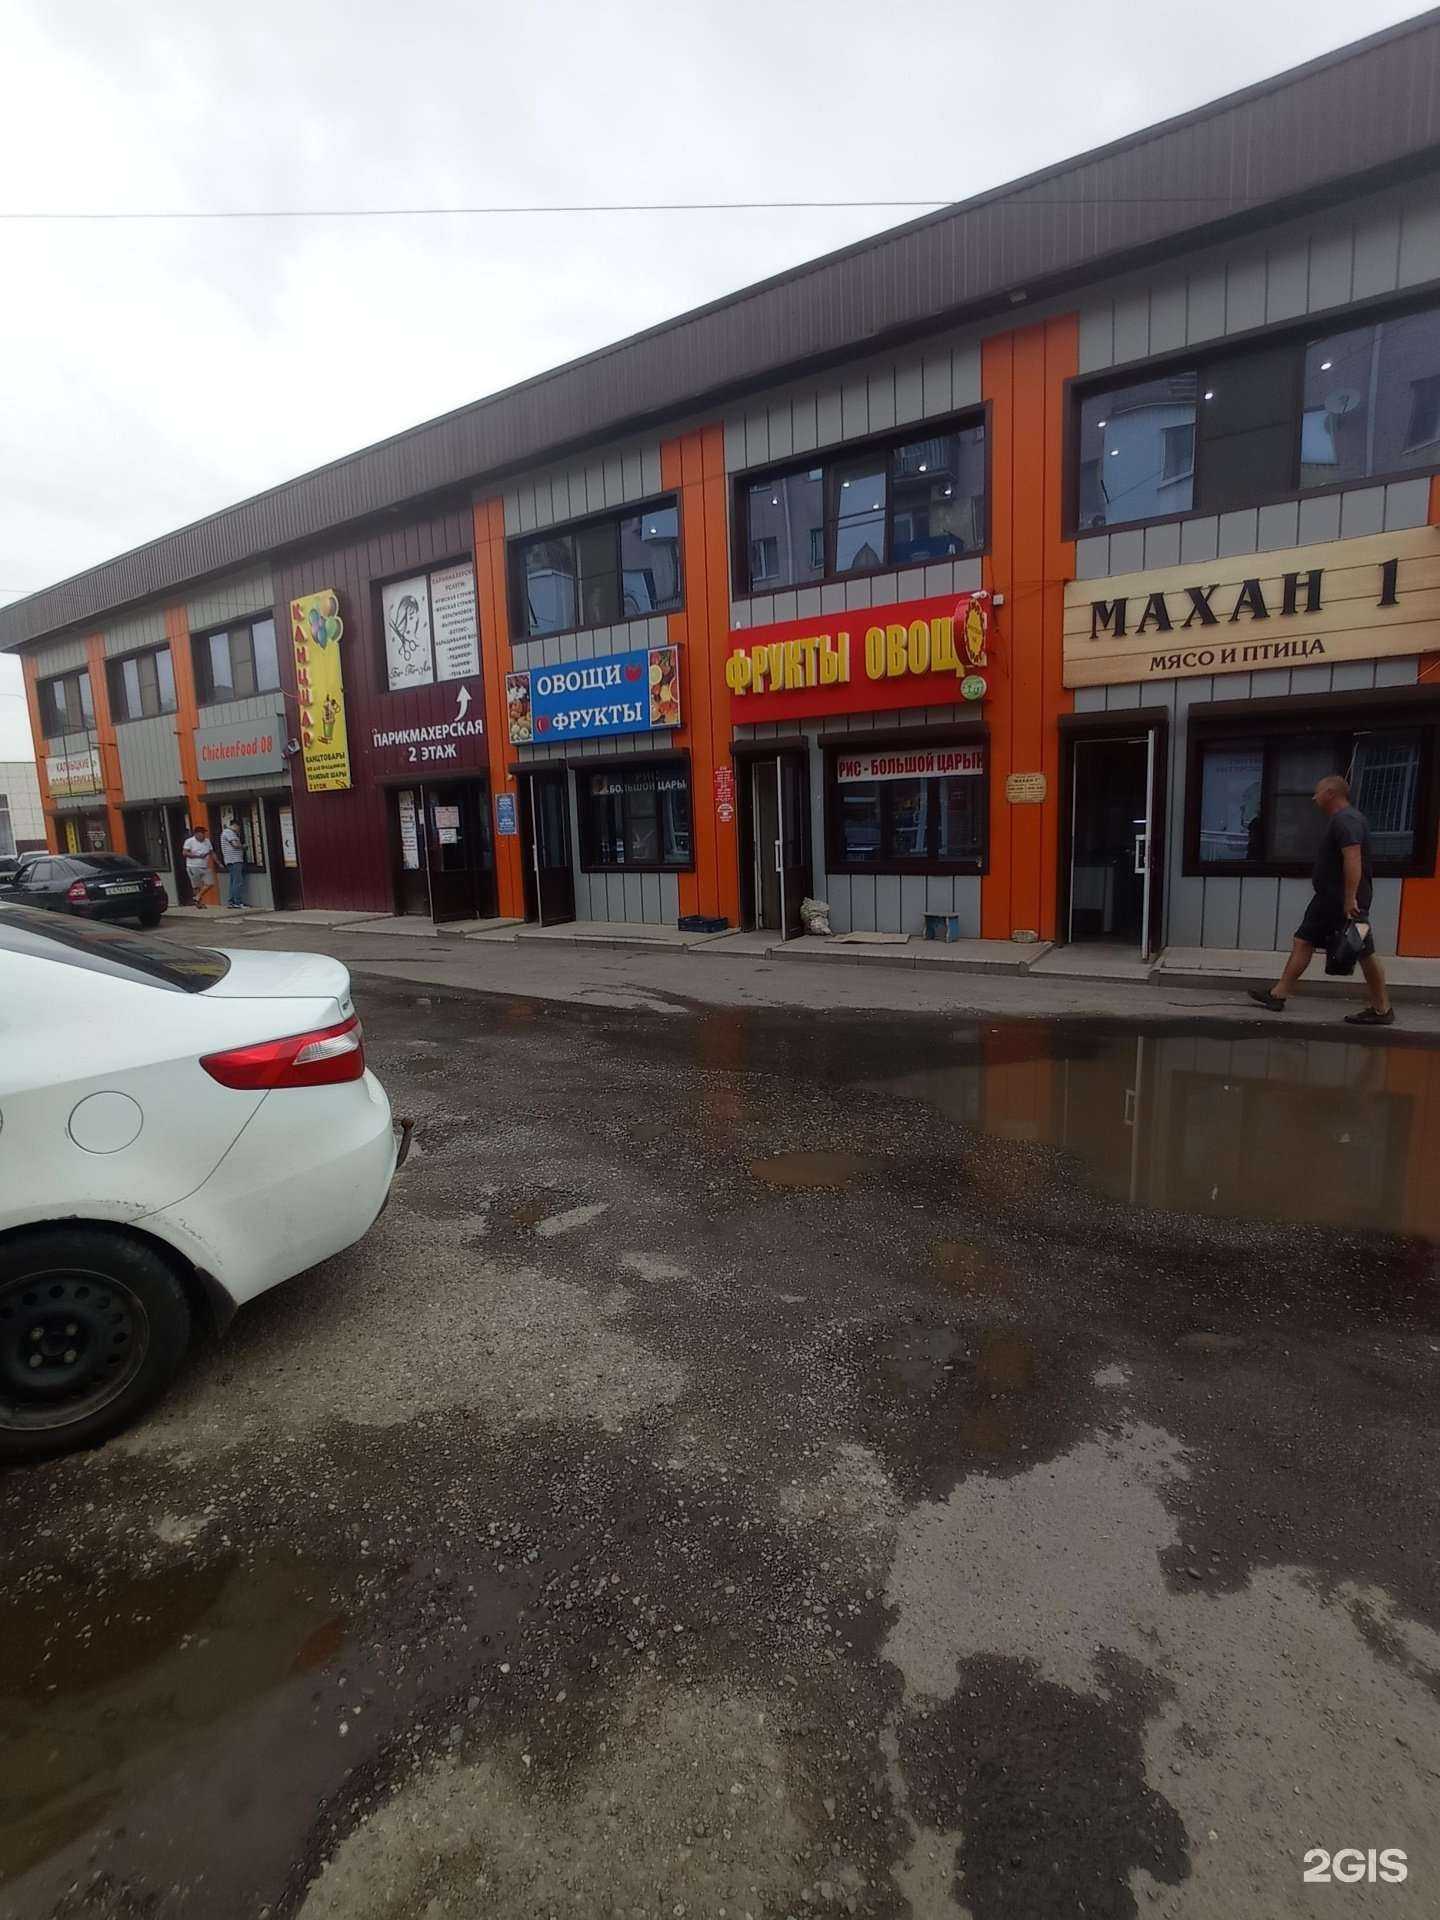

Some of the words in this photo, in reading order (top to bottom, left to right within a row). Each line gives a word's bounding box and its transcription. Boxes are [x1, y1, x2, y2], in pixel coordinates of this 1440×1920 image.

[1089, 568, 1324, 640] МАХАН
[1376, 557, 1400, 607] 1
[726, 632, 850, 695] ФРУКТЫ
[865, 611, 987, 680] ОВОЩ
[1150, 649, 1215, 672] МЯСО
[1220, 648, 1236, 664] И
[1243, 638, 1325, 663] ПТИЦА
[537, 664, 622, 696] ОВОЩИ
[552, 702, 643, 731] ФРУКТЫ
[373, 720, 484, 748] ПАРИКМАХЕРСКАЯ
[408, 746, 417, 762] 2
[421, 744, 457, 760] ЭТАЖ
[839, 760, 861, 778] РИС
[871, 753, 934, 775] БОЛЬШОЙ
